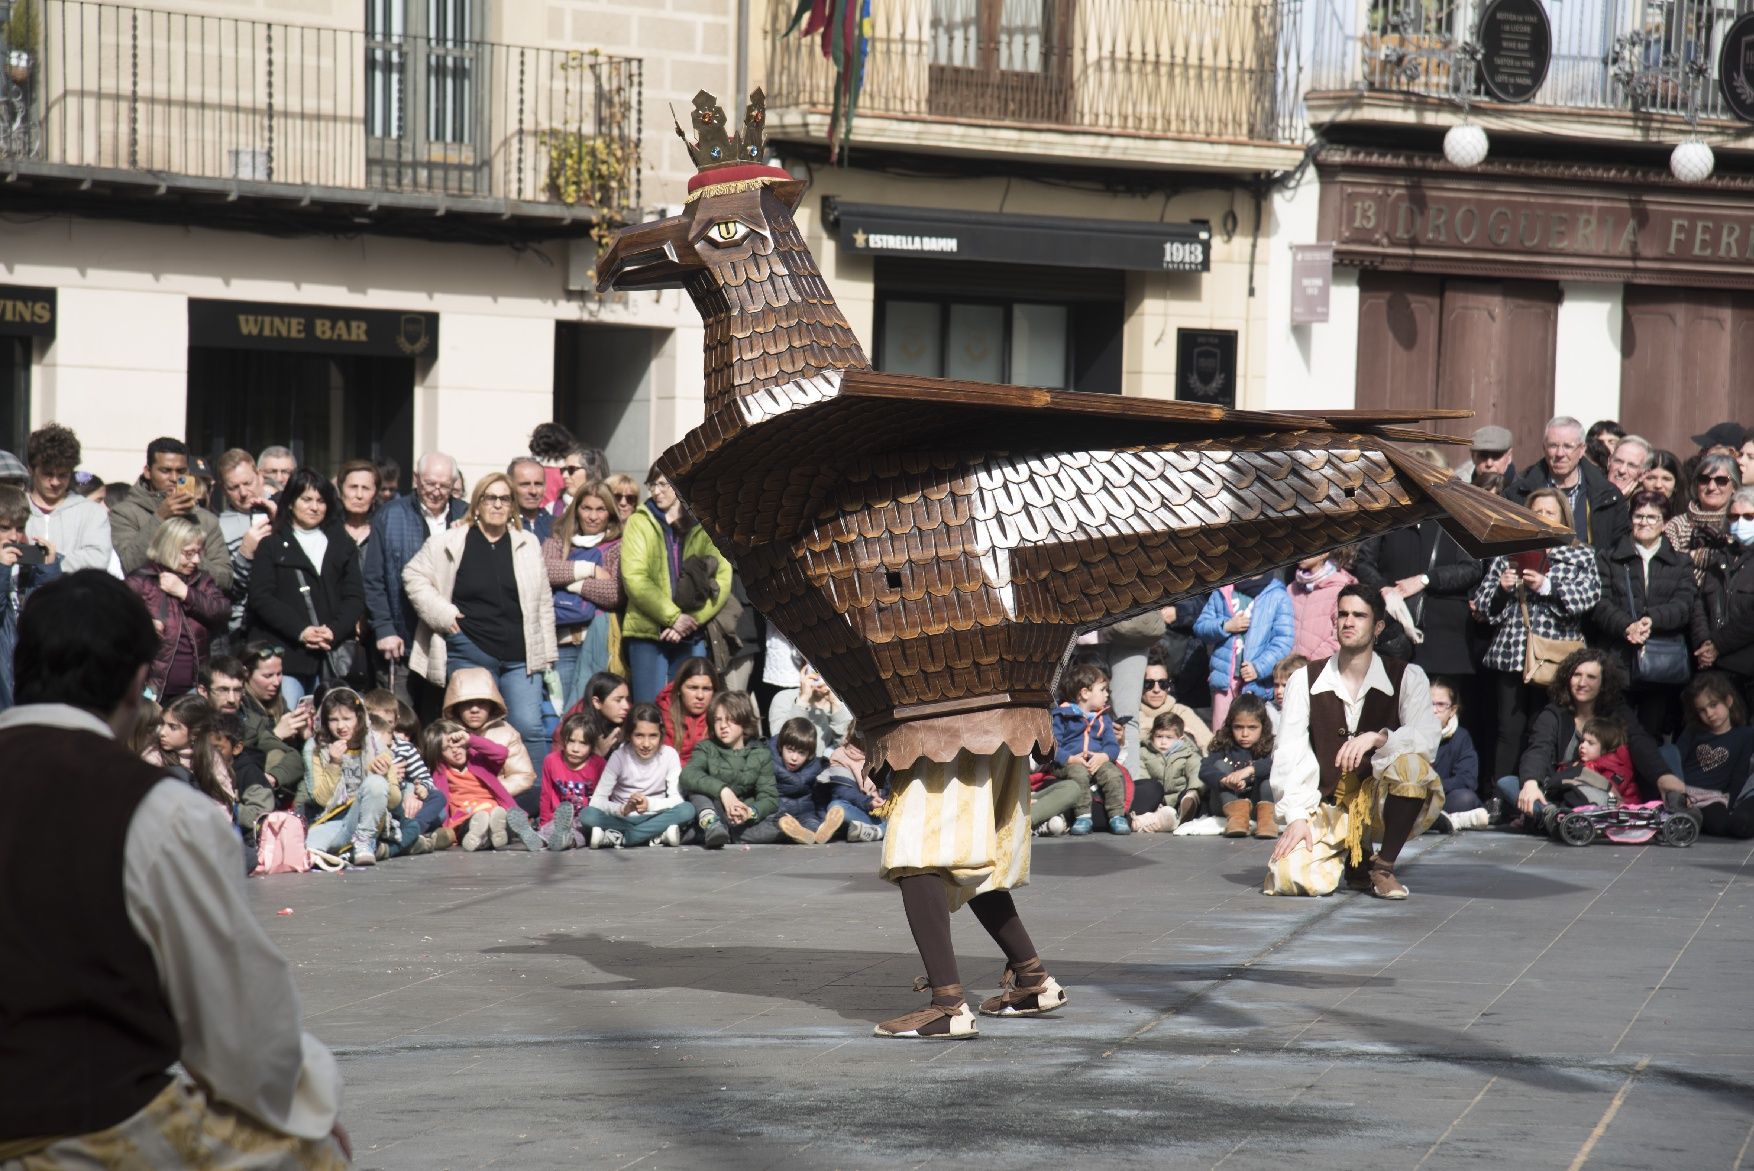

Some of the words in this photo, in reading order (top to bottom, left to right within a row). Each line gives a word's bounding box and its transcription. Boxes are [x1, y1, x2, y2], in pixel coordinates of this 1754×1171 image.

[1352, 201, 1377, 229] 13
[1395, 202, 1642, 254] DROGUERIA
[868, 234, 922, 250] ESTRELLA
[922, 236, 958, 252] DAMM
[1163, 241, 1203, 263] 1913
[238, 314, 306, 338] WINE
[313, 319, 368, 341] BAR
